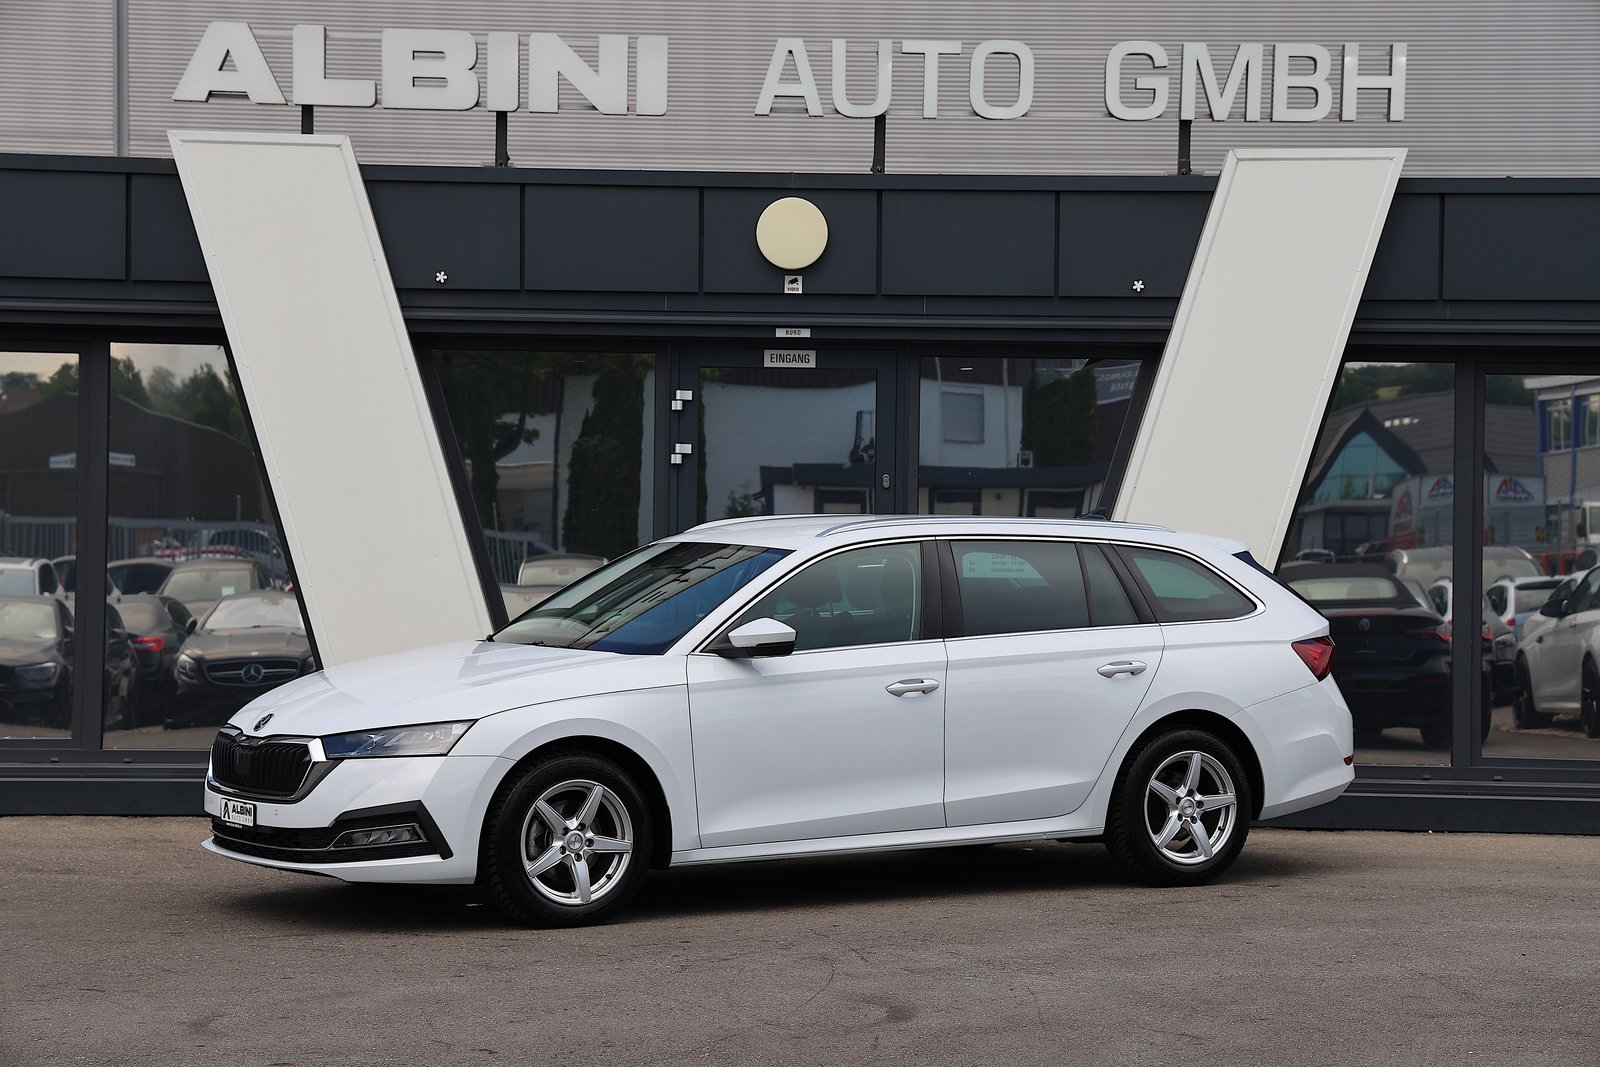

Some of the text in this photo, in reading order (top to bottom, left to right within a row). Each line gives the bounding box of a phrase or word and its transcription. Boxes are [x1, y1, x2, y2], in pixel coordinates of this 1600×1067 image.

[172, 21, 1408, 123] ALBINI AUTO GMBH
[770, 353, 810, 364] EINGANG
[232, 804, 252, 817] ALBINI
